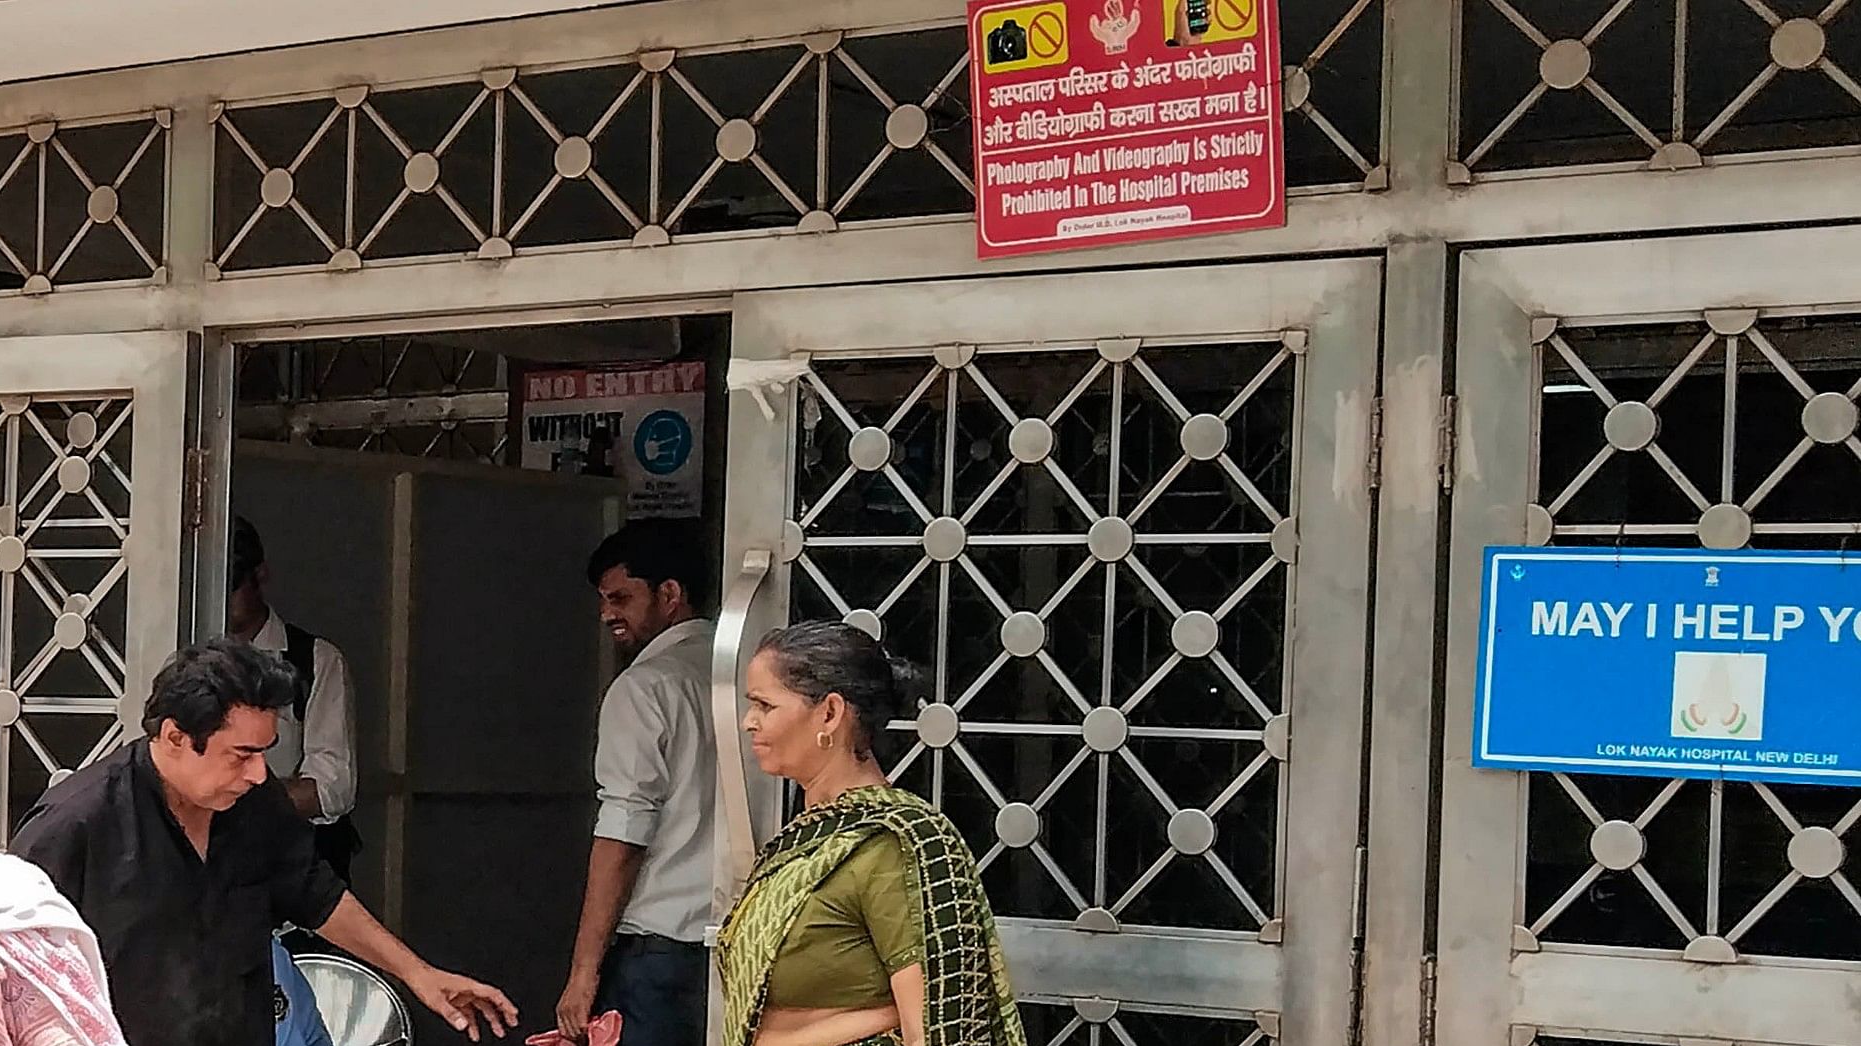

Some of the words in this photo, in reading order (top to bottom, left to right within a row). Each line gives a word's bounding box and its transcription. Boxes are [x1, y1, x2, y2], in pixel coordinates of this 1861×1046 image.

[988, 79, 1055, 108] अस्पताल
[1058, 66, 1108, 97] परिसर
[1111, 60, 1130, 89] के
[1133, 57, 1172, 87] अंदर
[984, 115, 1014, 145] और
[1015, 101, 1106, 140] वीडियोग्राफी
[1108, 103, 1156, 128] करना
[1204, 92, 1240, 115] मना
[987, 154, 1070, 186] Photography
[1073, 149, 1100, 175] And
[1103, 139, 1190, 172] Videography
[1194, 135, 1207, 161] Is
[1210, 129, 1263, 159] Strictly
[1001, 185, 1071, 217] Prohibited
[1074, 184, 1088, 207] In
[1090, 181, 1116, 205] The
[1120, 172, 1177, 202] Hospital
[1180, 167, 1249, 195] Premises
[529, 375, 577, 401] NO
[586, 364, 701, 397] ENTRY
[1531, 601, 1634, 638] MAY
[1646, 603, 1658, 639] I
[1673, 603, 1805, 641] HELP
[1596, 743, 1626, 757] LOK
[1630, 745, 1677, 759] NAYAK
[1681, 748, 1752, 762] HOSPITAL
[1755, 751, 1789, 763] NEW
[1793, 752, 1839, 766] DELHI
